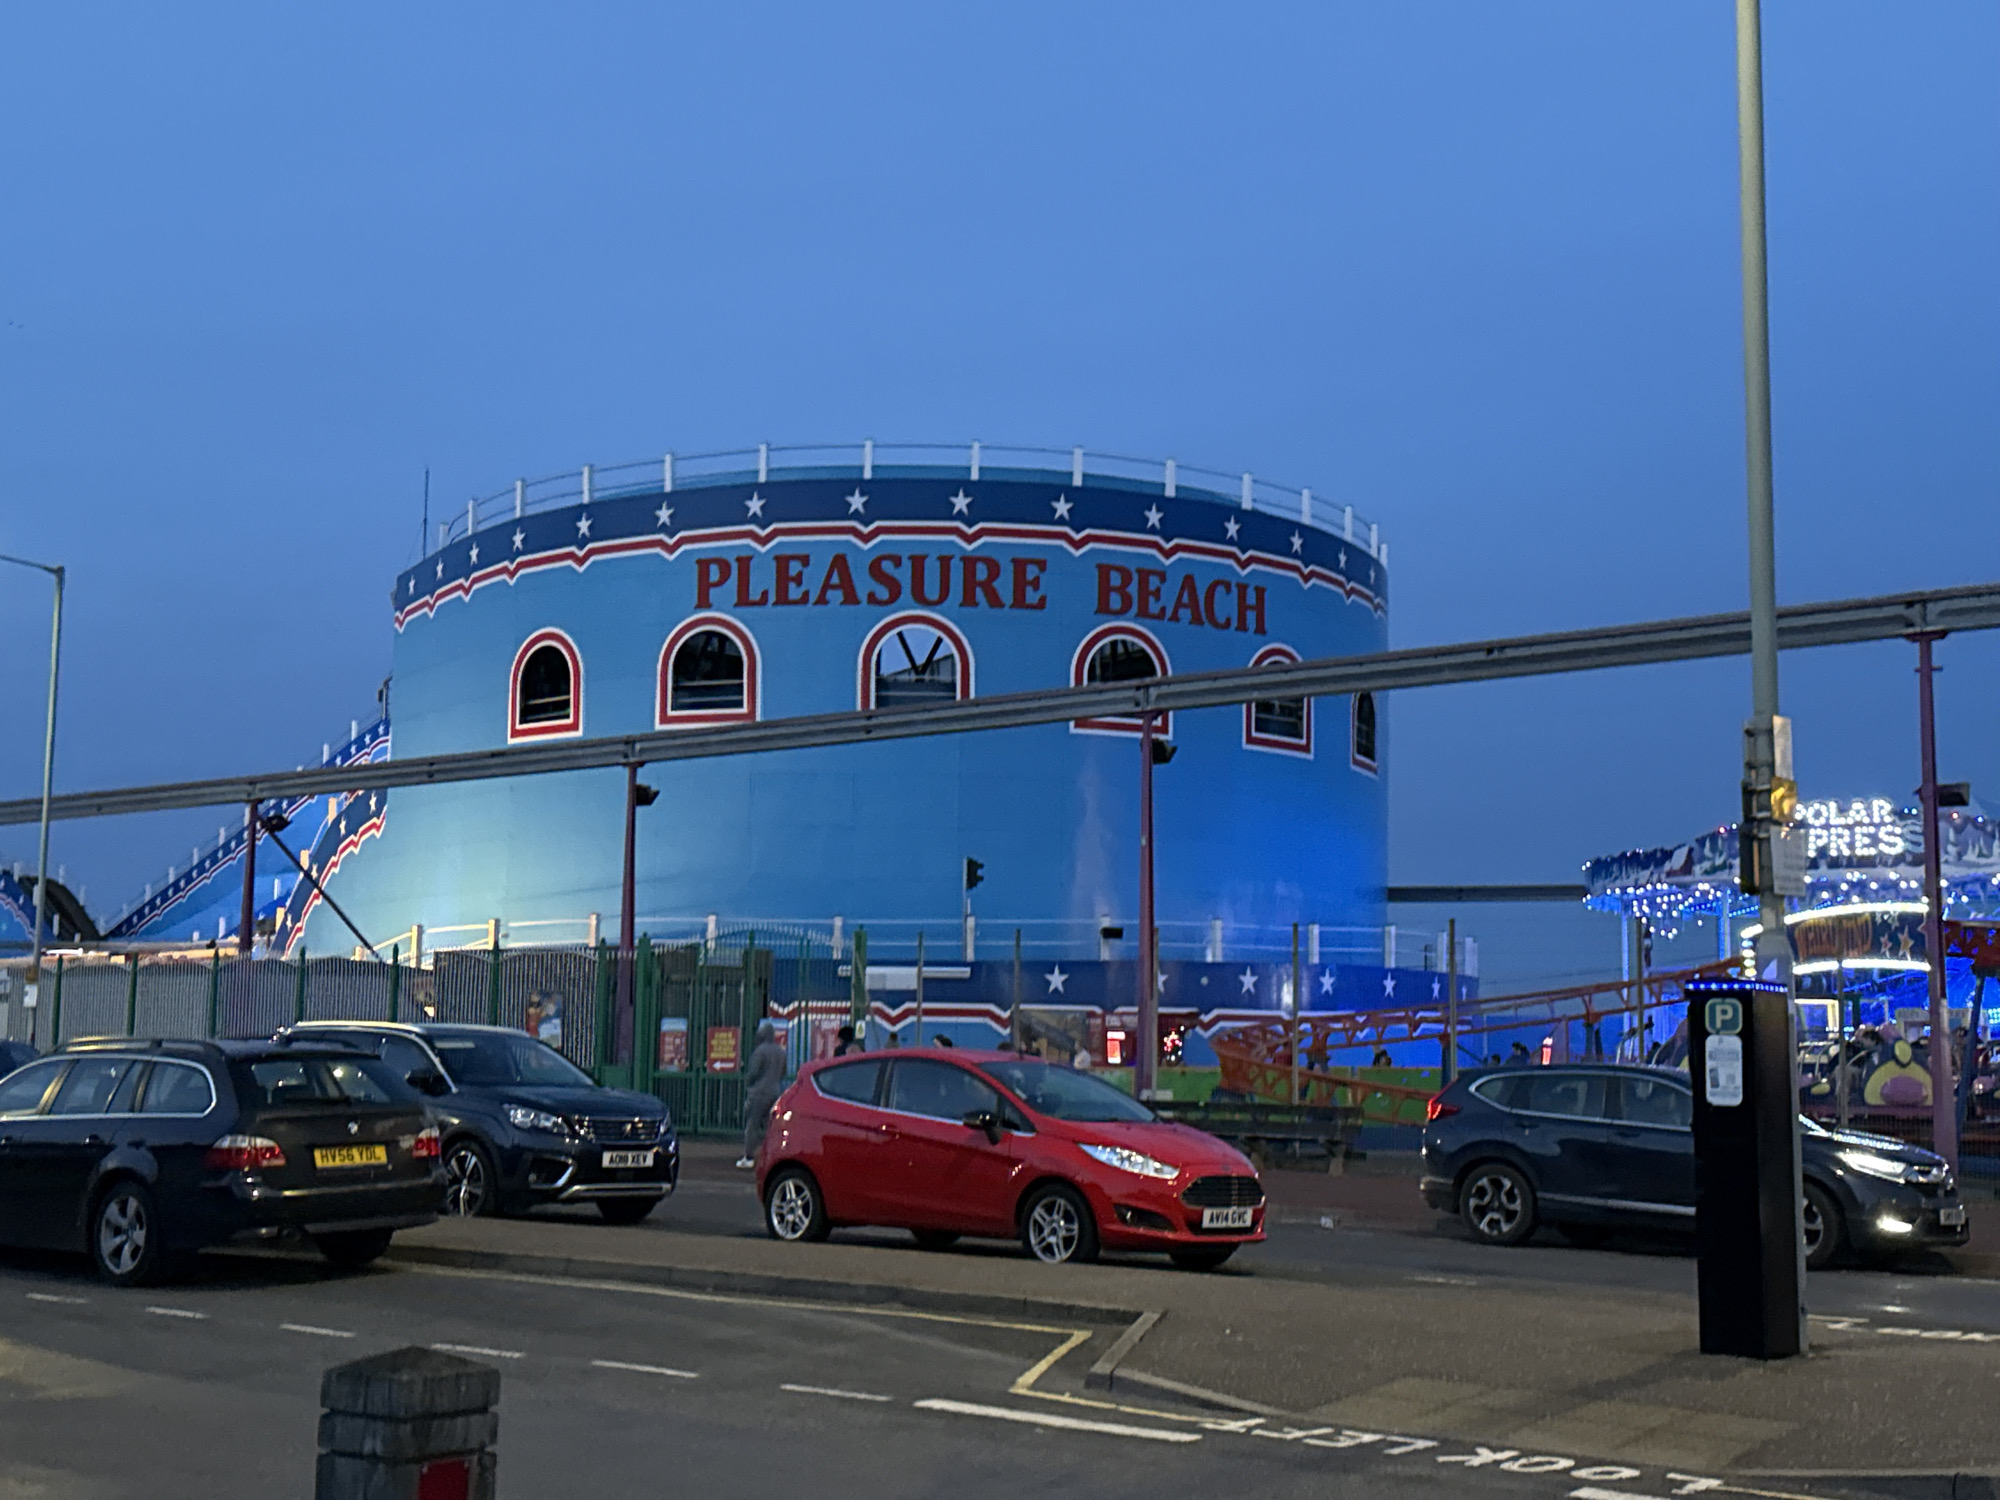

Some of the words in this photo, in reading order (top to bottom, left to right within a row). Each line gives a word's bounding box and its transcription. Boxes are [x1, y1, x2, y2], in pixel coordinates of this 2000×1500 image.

[694, 553, 1047, 609] PLEASURE
[1094, 563, 1267, 635] BEACH
[1715, 1004, 1733, 1029] P
[1198, 1417, 1438, 1454] LEFT
[1436, 1446, 1724, 1495] LOOK
